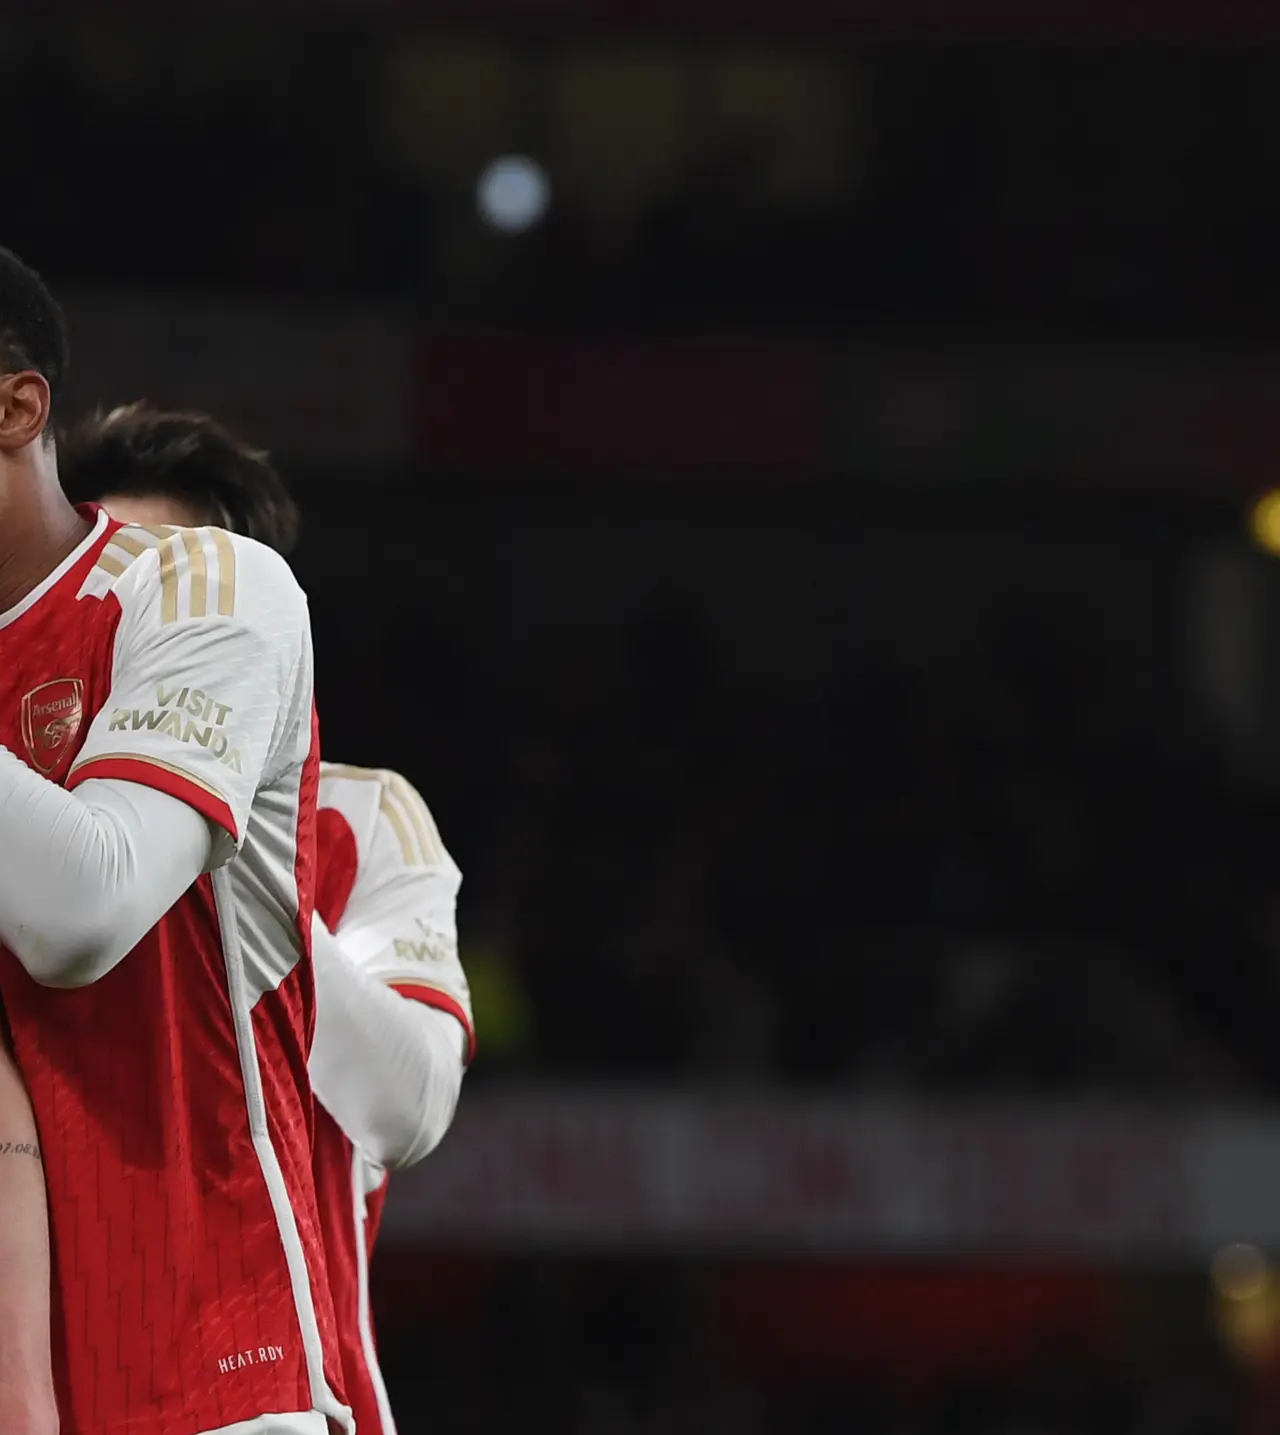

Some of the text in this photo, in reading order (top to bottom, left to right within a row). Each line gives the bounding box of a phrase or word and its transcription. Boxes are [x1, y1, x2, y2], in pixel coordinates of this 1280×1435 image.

[32, 692, 76, 718] Arsenal
[156, 684, 233, 726] VISIT
[108, 707, 243, 775] RWANDA
[218, 1345, 284, 1374] HEAT.RDY
